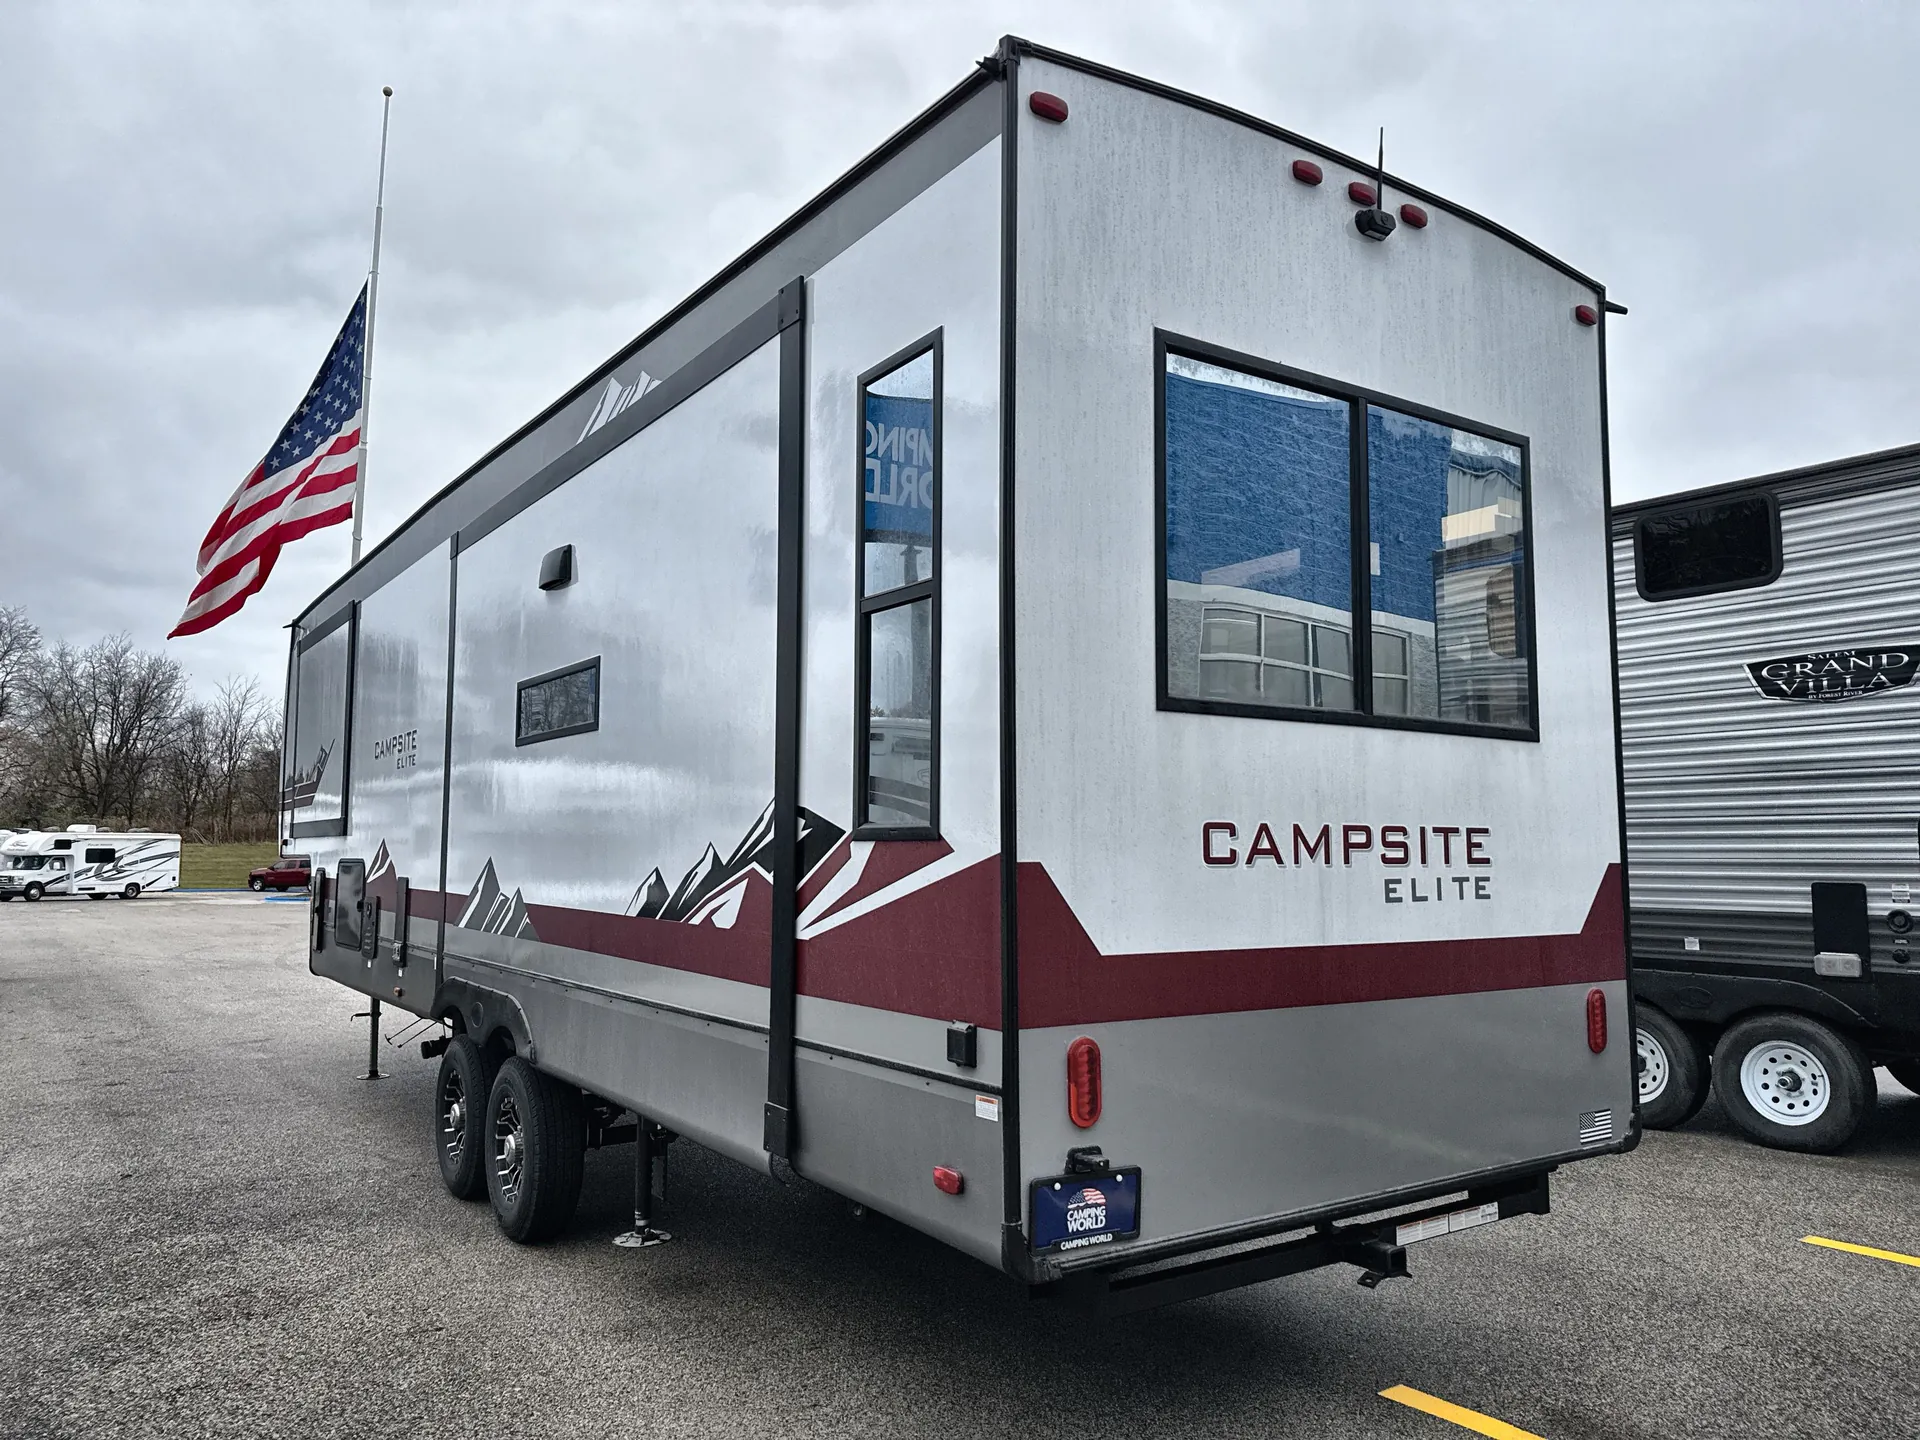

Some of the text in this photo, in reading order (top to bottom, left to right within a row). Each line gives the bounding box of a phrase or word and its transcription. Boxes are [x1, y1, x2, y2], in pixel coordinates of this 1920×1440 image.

[1807, 650, 1856, 660] SALEM
[1761, 652, 1910, 680] GRAND
[1774, 672, 1896, 696] VILLA
[1819, 691, 1842, 699] FOREST
[374, 729, 418, 760] CAMPSITE
[396, 753, 416, 770] ELITE
[1201, 821, 1492, 866] CAMPSITE
[1384, 876, 1492, 904] ELITE
[1067, 1205, 1106, 1221] CAMPING
[1067, 1216, 1106, 1233] WORLD
[1060, 1233, 1113, 1250] CAMPING WORLD
